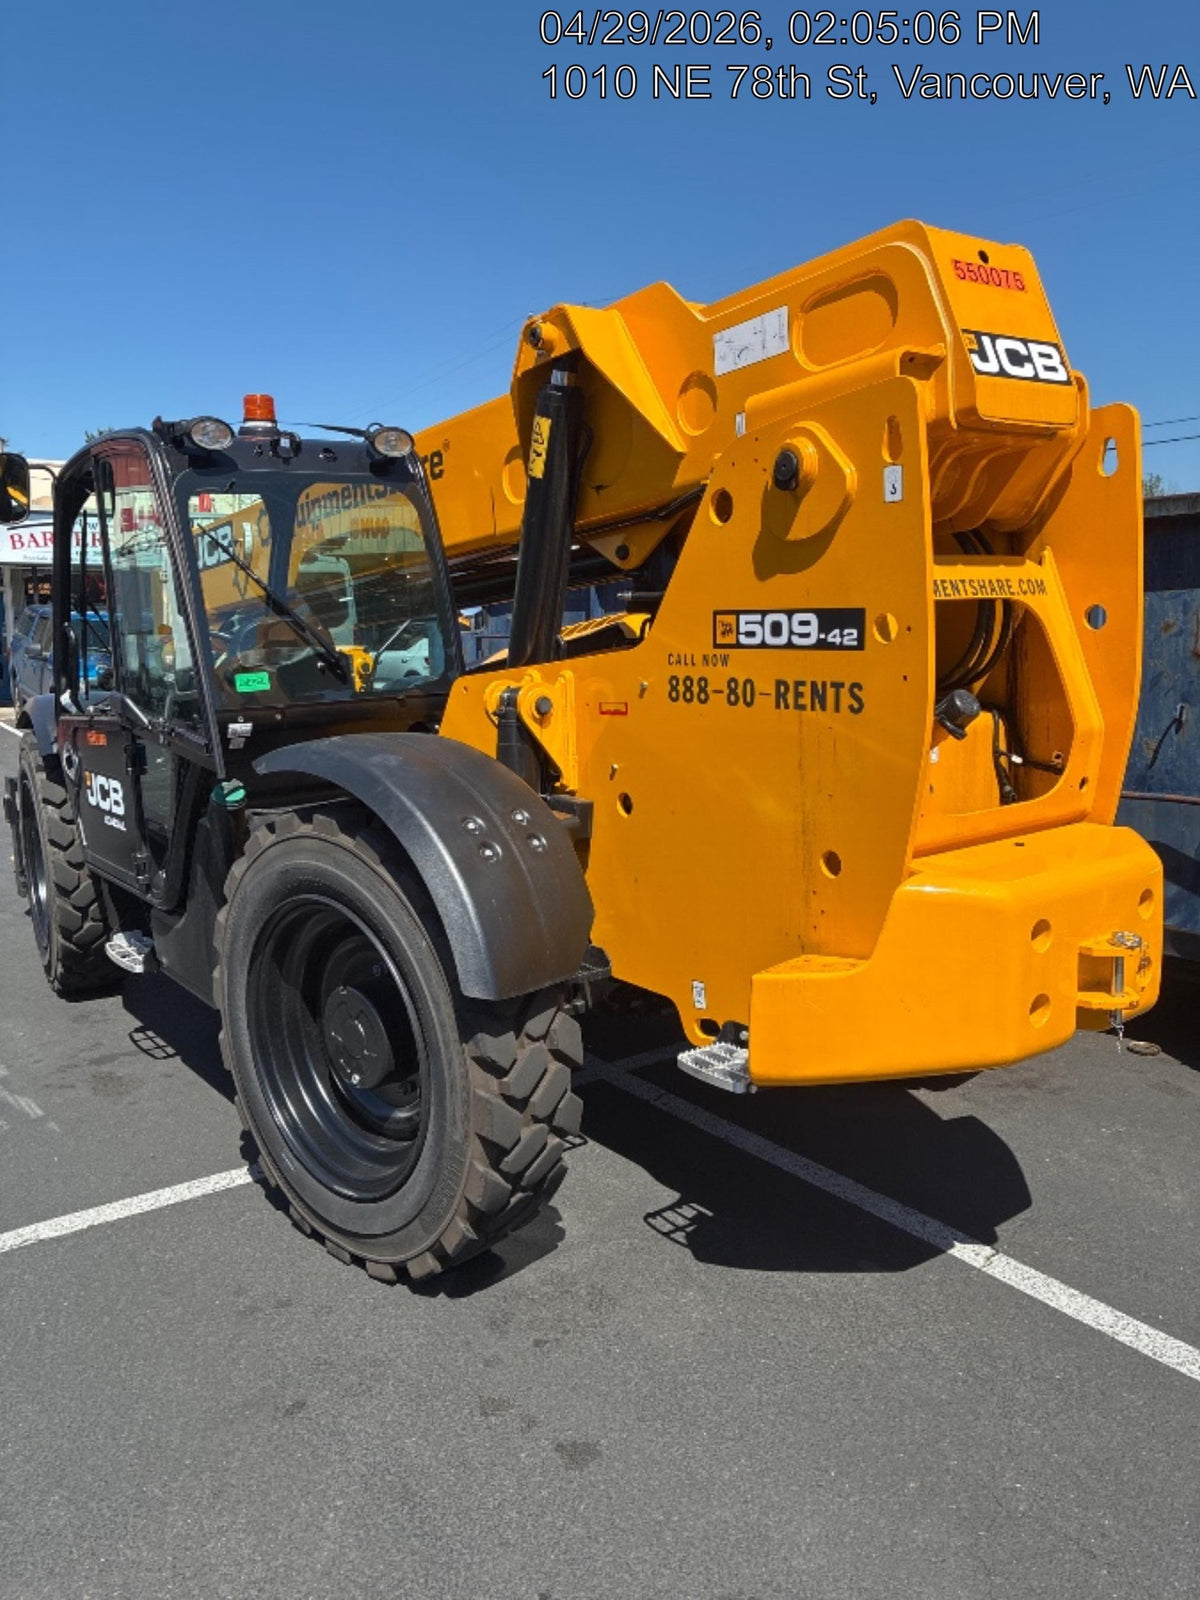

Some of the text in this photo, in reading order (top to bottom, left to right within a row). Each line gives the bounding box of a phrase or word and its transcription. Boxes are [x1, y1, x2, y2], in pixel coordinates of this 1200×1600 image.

[953, 259, 1026, 292] 550075
[970, 335, 1068, 382] JCB
[738, 612, 859, 646] 509-42
[668, 653, 730, 667] CALL NOW
[668, 675, 865, 715] 888-80-RENTS
[86, 771, 125, 816] JCB
